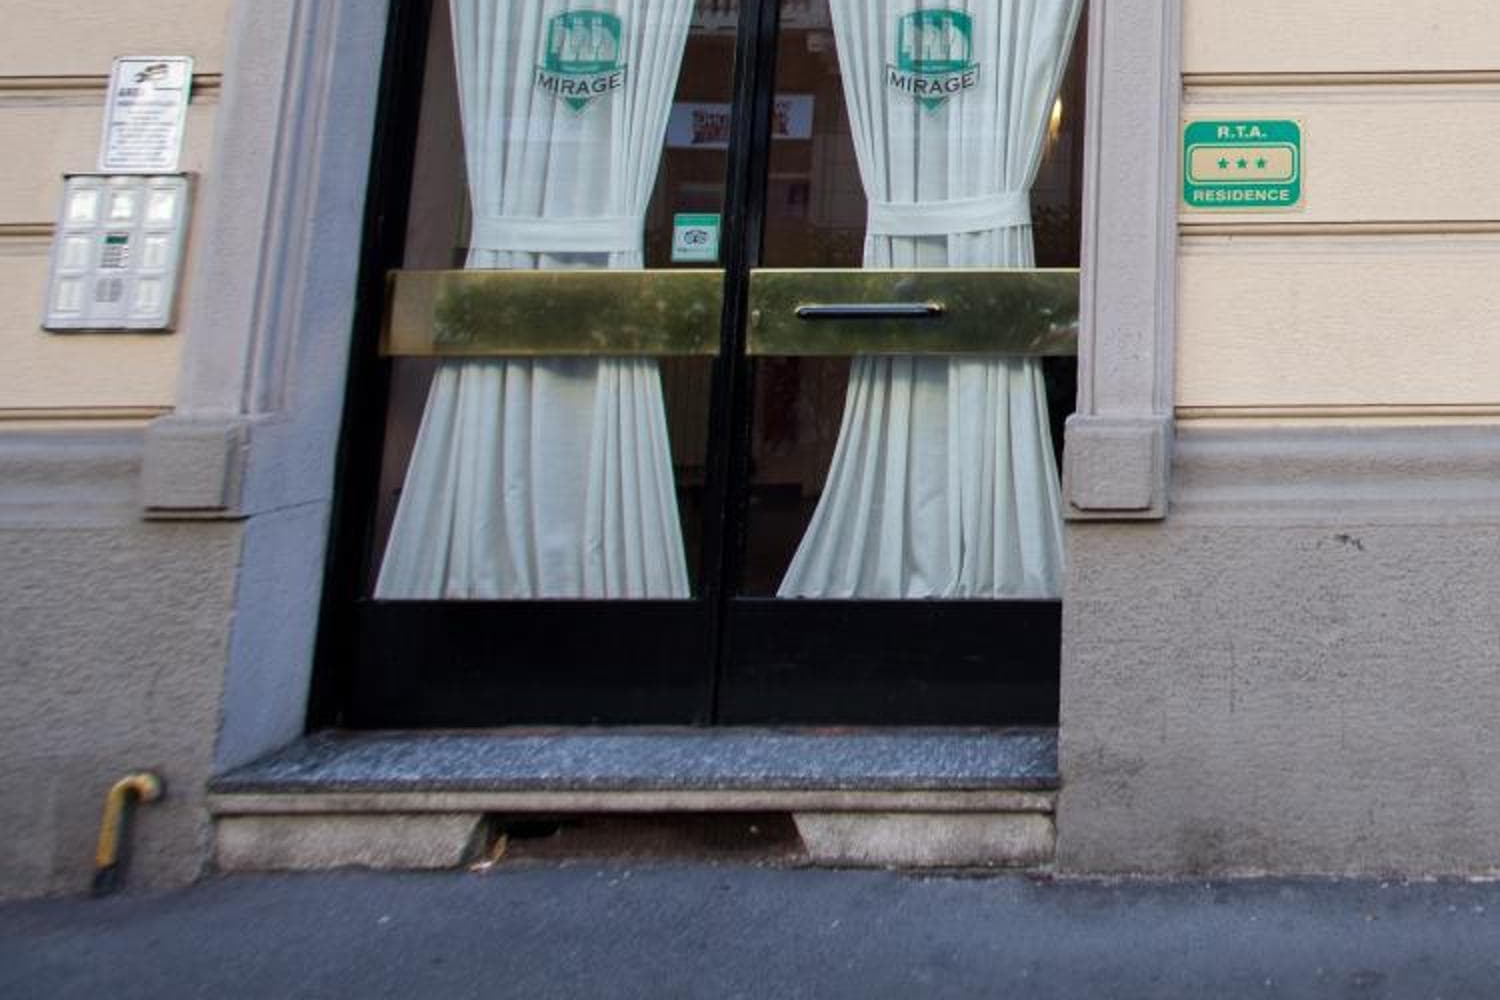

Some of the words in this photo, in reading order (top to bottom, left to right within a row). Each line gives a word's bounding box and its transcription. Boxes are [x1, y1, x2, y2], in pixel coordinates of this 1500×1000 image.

[537, 71, 622, 94] MIRAGE
[890, 71, 976, 94] MIRAGE
[1217, 126, 1267, 139] R.T.A.
[1193, 189, 1291, 201] RESIDENCE
